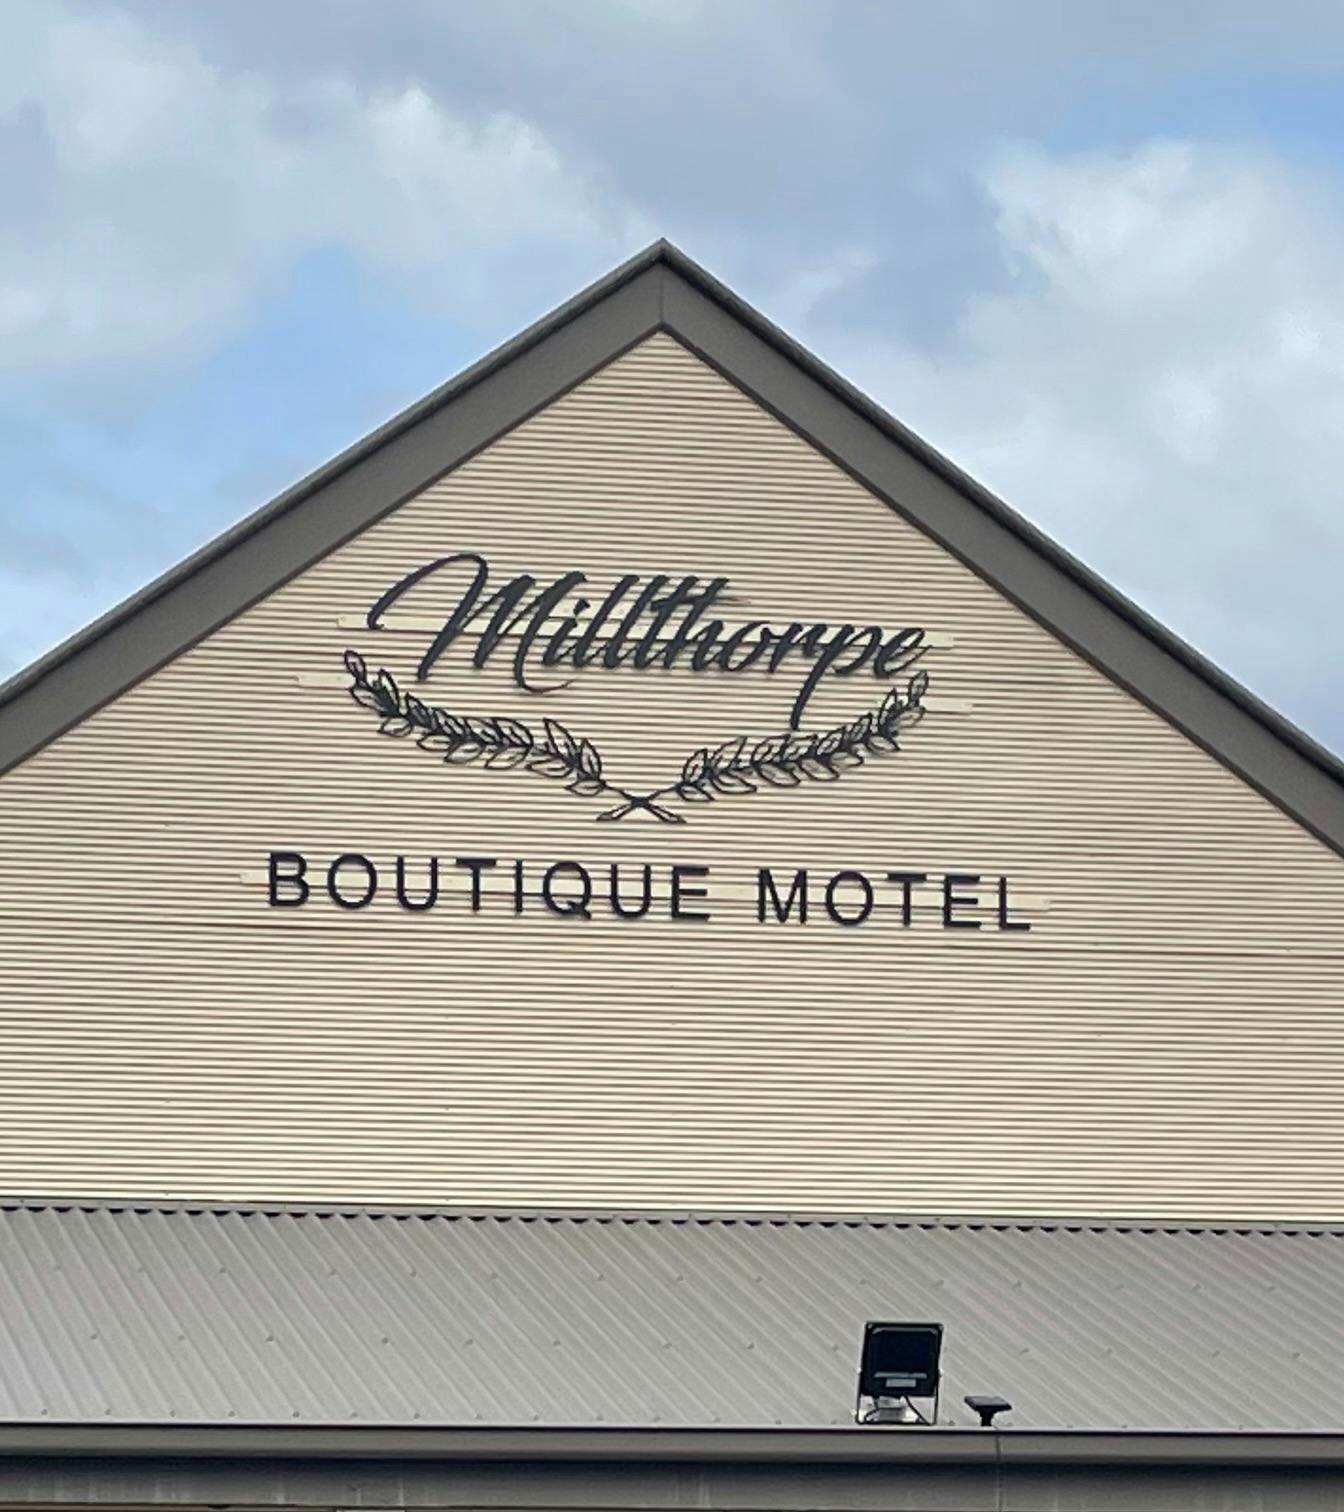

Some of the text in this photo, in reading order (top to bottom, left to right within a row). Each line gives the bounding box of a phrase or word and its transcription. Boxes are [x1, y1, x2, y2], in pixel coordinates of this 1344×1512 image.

[367, 553, 932, 730] Millthorpe
[268, 851, 1031, 931] BOUTIQUE MOTEL
